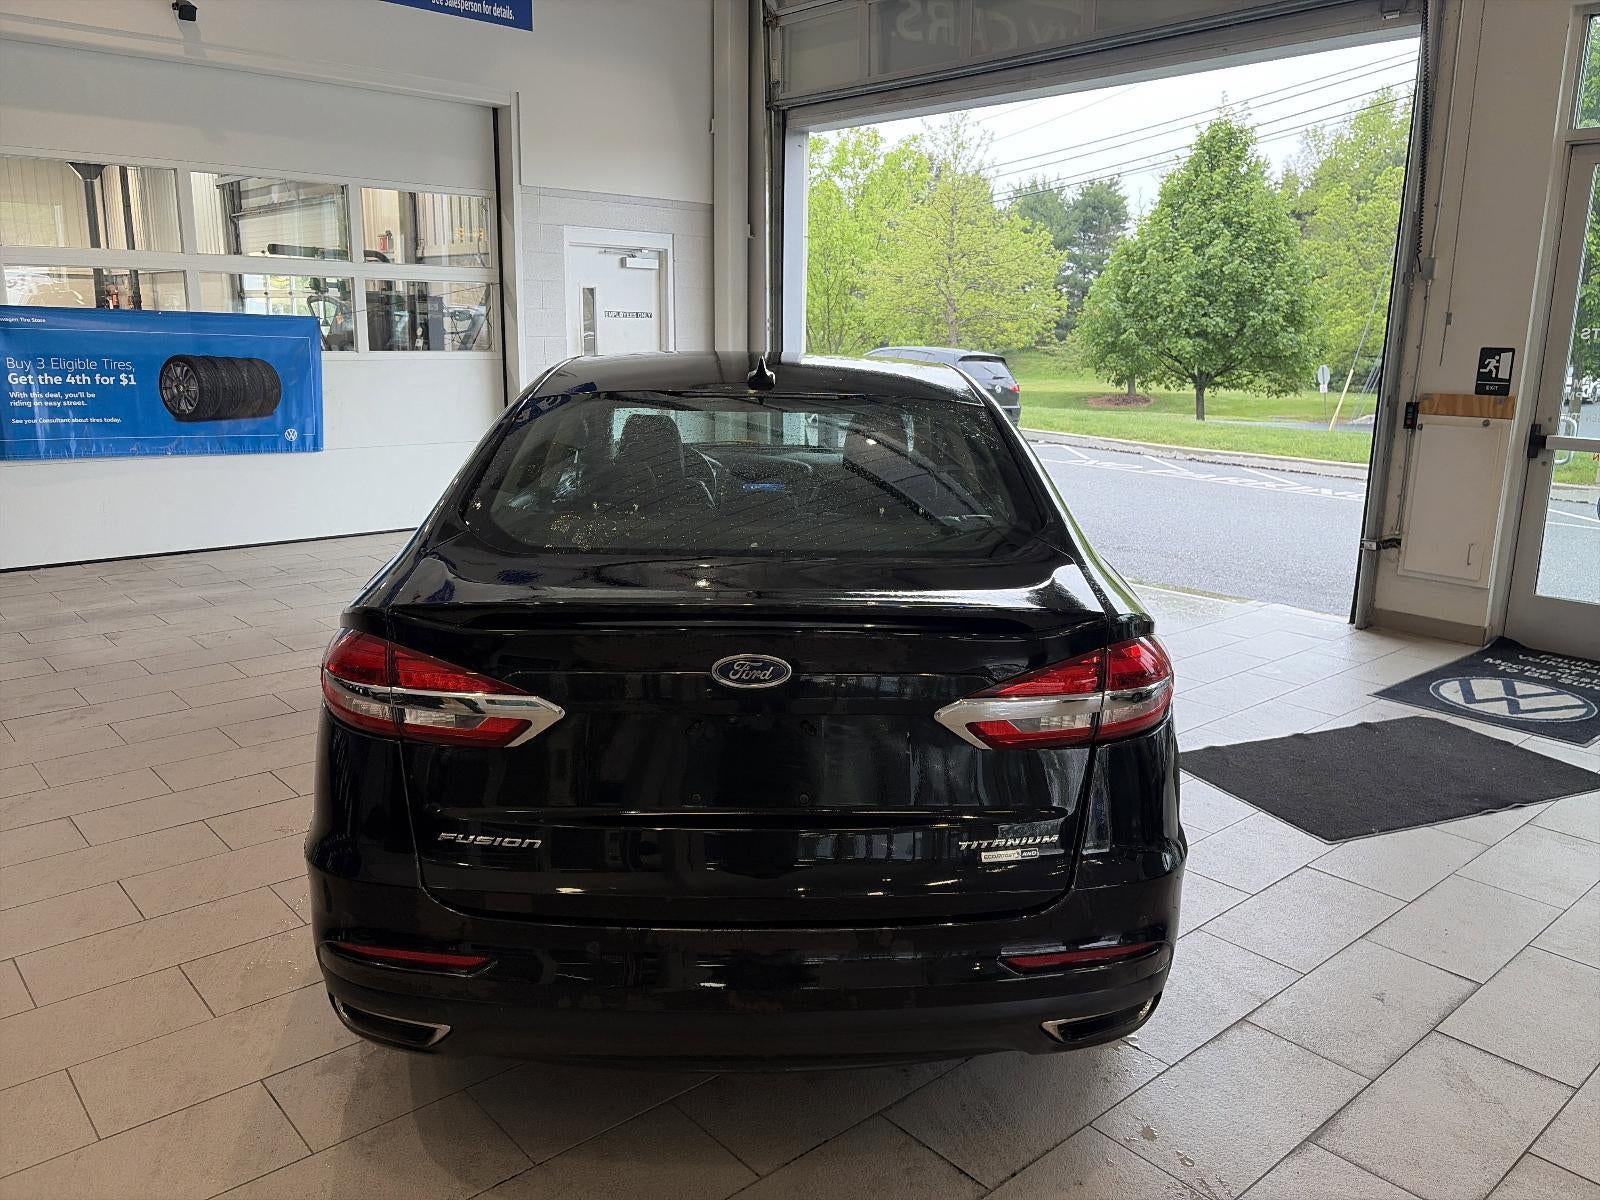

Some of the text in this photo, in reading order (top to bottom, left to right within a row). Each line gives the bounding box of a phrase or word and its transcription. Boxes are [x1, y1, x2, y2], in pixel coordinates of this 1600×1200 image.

[445, 0, 482, 13] Salesperson
[482, 2, 492, 15] for
[493, 3, 515, 20] details.
[6, 357, 135, 372] Buy 3 Eligible Tires,
[8, 373, 137, 387] Get the 4th for $1
[45, 392, 63, 400] deal,
[64, 392, 85, 400] you'll
[9, 400, 32, 408] riding
[729, 661, 774, 680] Ford
[1498, 665, 1520, 673] To
[1524, 671, 1552, 680] Be
[437, 832, 542, 849] FUSION
[958, 834, 1060, 851] TITANIUM
[1021, 850, 1038, 858] AWD
